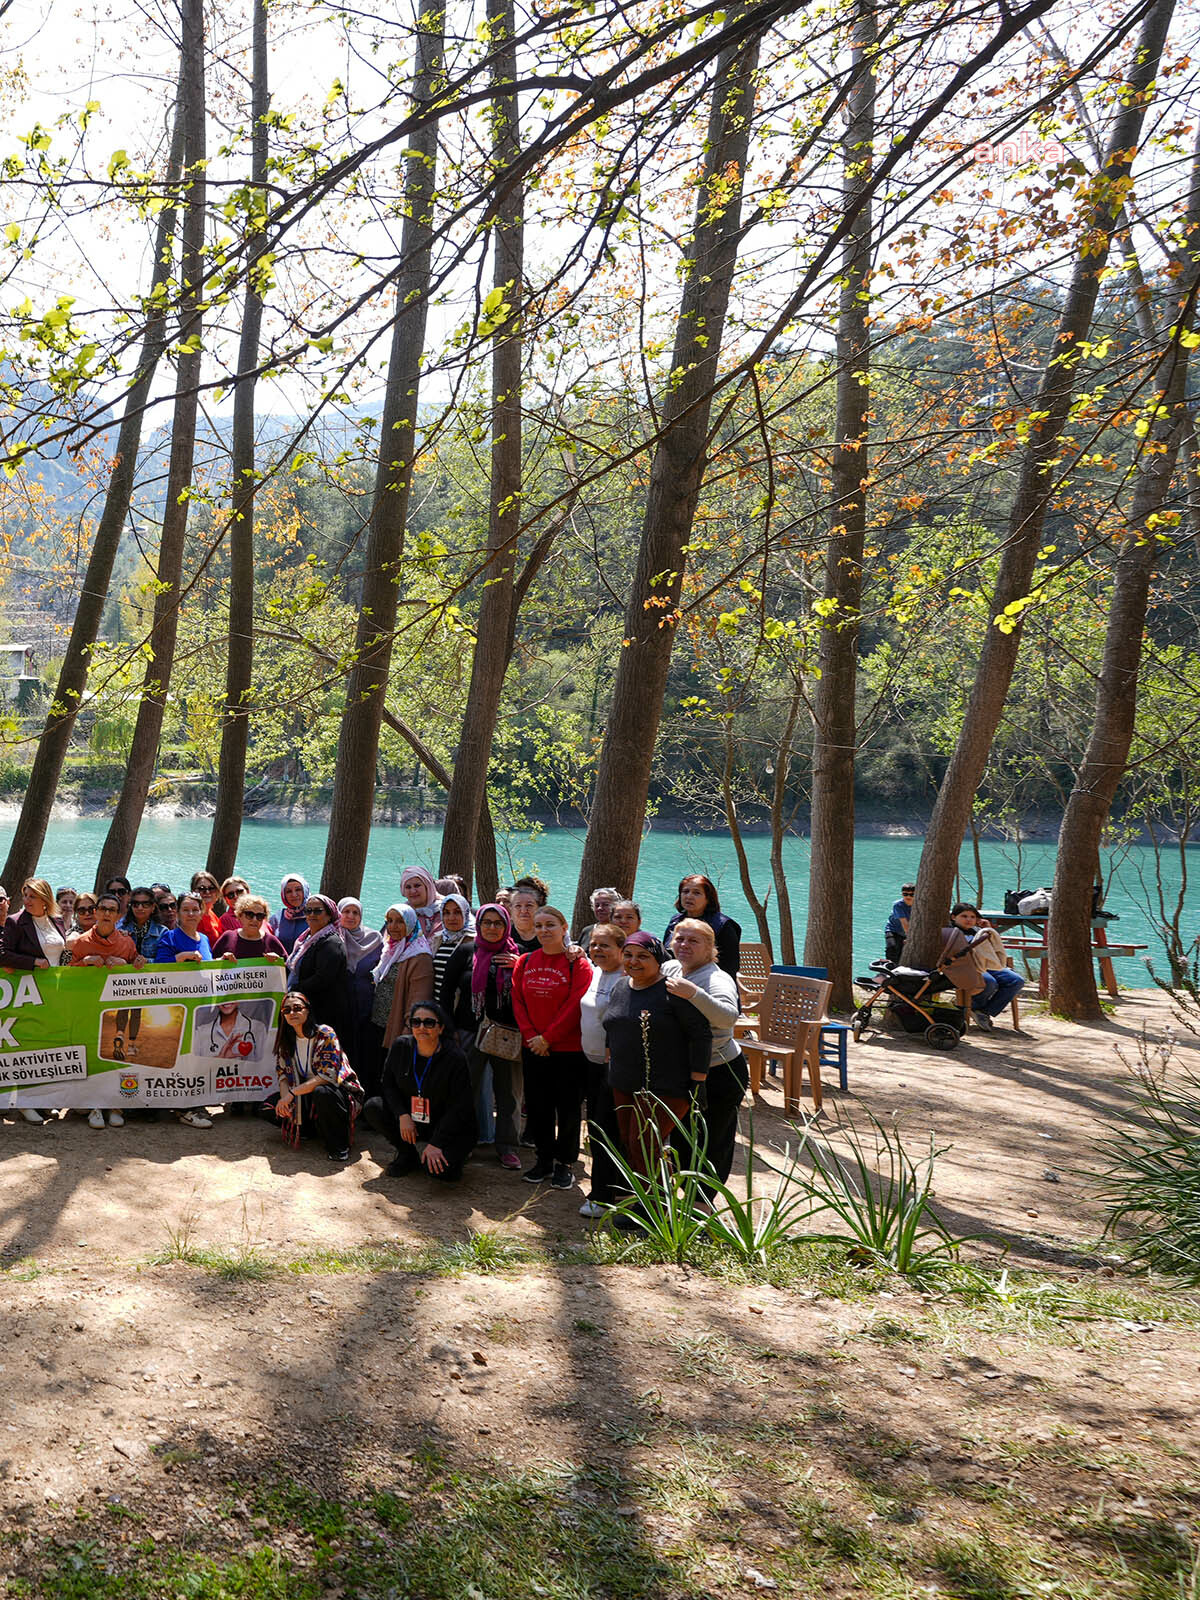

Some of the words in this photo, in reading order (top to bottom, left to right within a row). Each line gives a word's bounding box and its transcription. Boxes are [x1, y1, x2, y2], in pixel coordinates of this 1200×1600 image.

[112, 977, 136, 987] KADIN
[138, 977, 148, 985] VE
[150, 975, 166, 985] AİLE
[215, 972, 241, 982] SAĞLIK
[243, 970, 267, 980] İŞLERİ
[113, 986, 158, 997] HİZMETLERİ
[160, 985, 208, 995] MÜDÜRLÜĞÜ
[216, 981, 263, 992] MÜDÜRLÜĞÜ
[12, 1051, 62, 1067] AKTİVİTE
[64, 1050, 80, 1060] VE
[12, 1062, 83, 1079] SÖYLEŞİLERİ
[144, 1076, 205, 1089] TARSUS
[216, 1075, 273, 1089] BOLTAÇ
